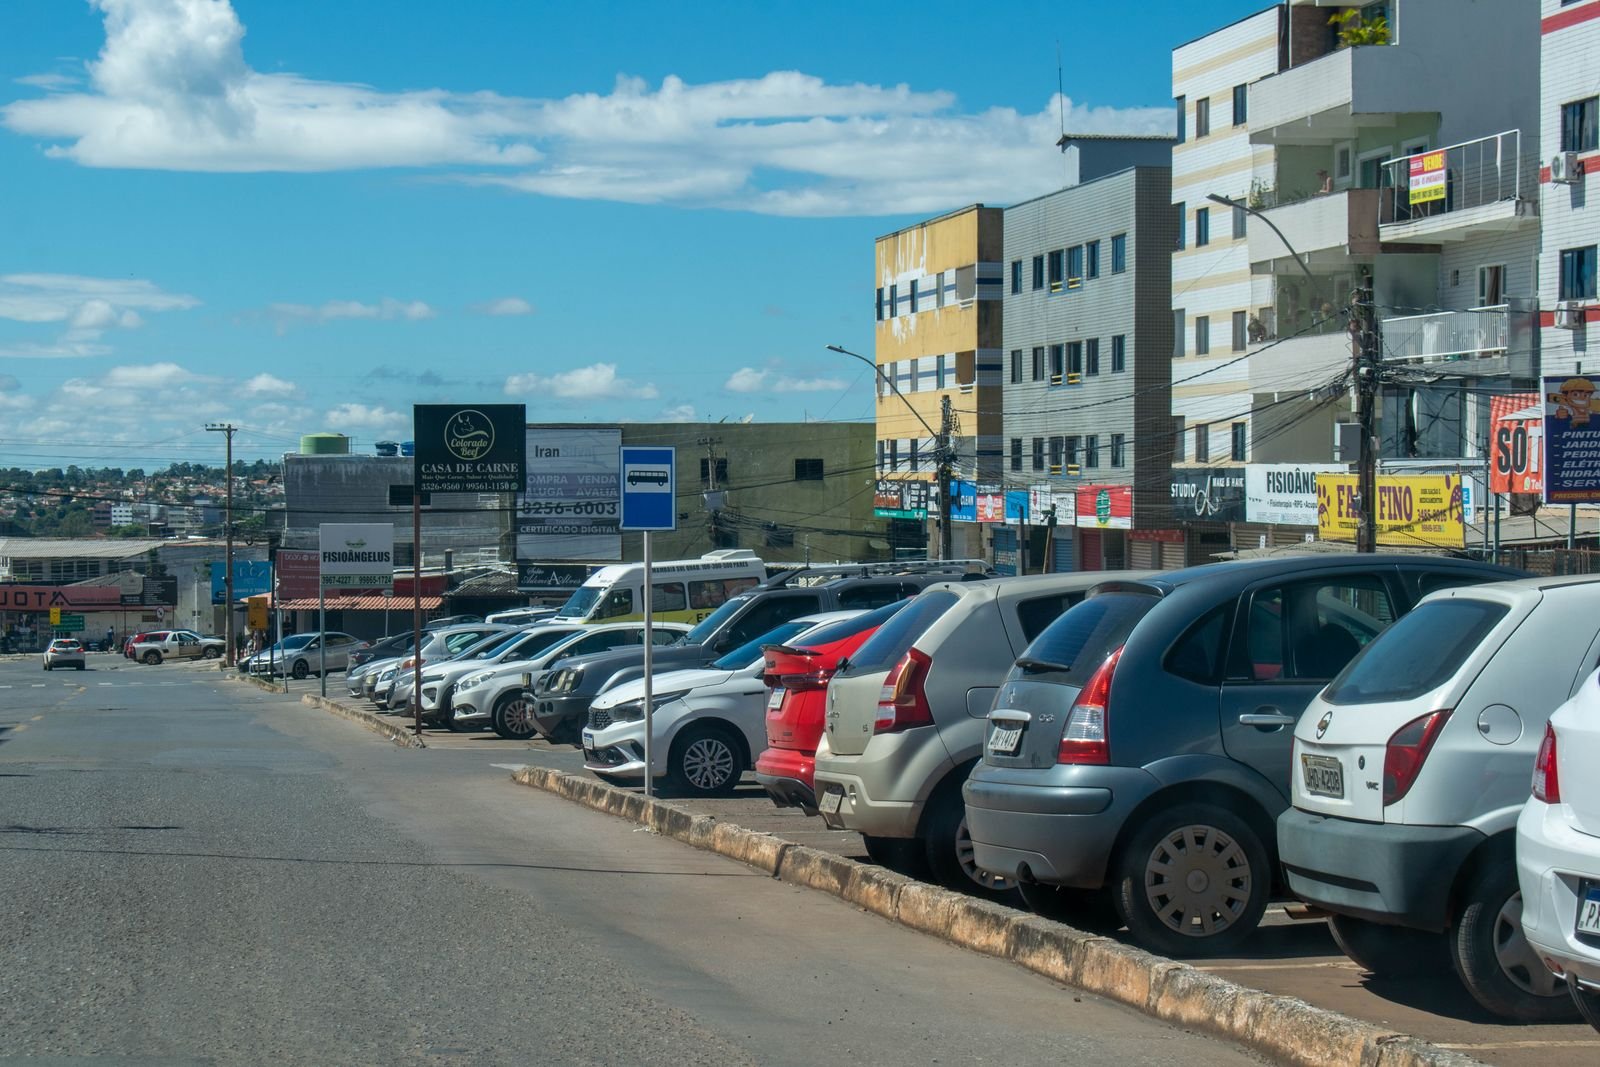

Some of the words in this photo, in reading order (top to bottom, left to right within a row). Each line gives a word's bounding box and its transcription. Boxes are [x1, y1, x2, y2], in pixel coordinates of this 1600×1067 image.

[450, 438, 488, 448] Colorado
[460, 447, 480, 458] Beef
[535, 445, 560, 458] Iran
[421, 463, 452, 473] CASA
[456, 463, 473, 473] DE
[476, 463, 519, 473] CARNE
[527, 475, 568, 484] OMPRA
[576, 475, 617, 484] VENDA
[526, 488, 564, 496] ALUGA
[576, 488, 618, 496] AVALIA
[1171, 483, 1196, 498] STUDIO
[1378, 485, 1413, 521] FINO
[322, 550, 390, 563] FISIOÂNGELUS
